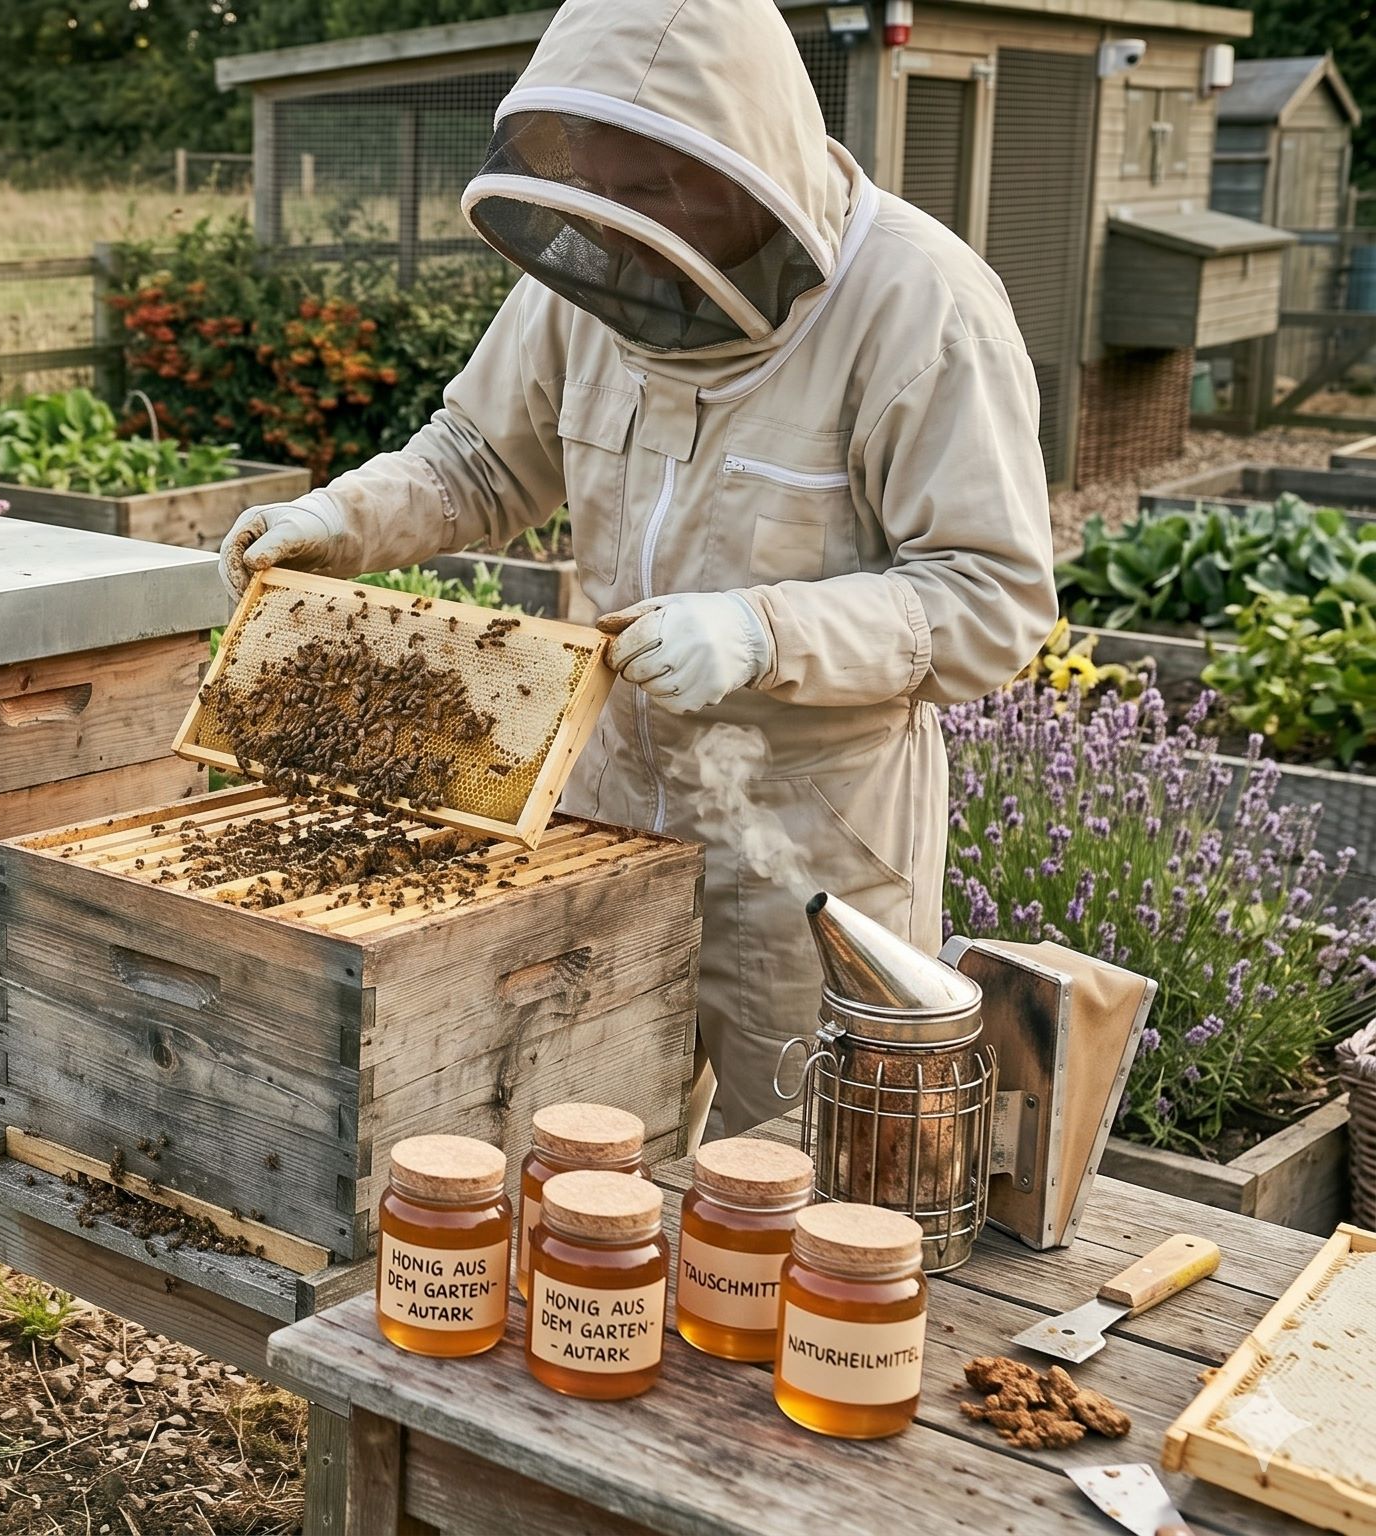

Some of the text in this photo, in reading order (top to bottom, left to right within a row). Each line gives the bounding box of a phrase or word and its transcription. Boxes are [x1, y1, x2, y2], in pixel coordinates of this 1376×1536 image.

[392, 1248, 486, 1277] HONIG AUS
[388, 1269, 498, 1299] DEM GARTEN-
[683, 1259, 781, 1298] TAUSCHMITT
[408, 1302, 473, 1322] AUTARK
[546, 1288, 644, 1317] HONIG AUS
[542, 1309, 655, 1340] DEM GARTEN-
[563, 1343, 630, 1362] AUTARK
